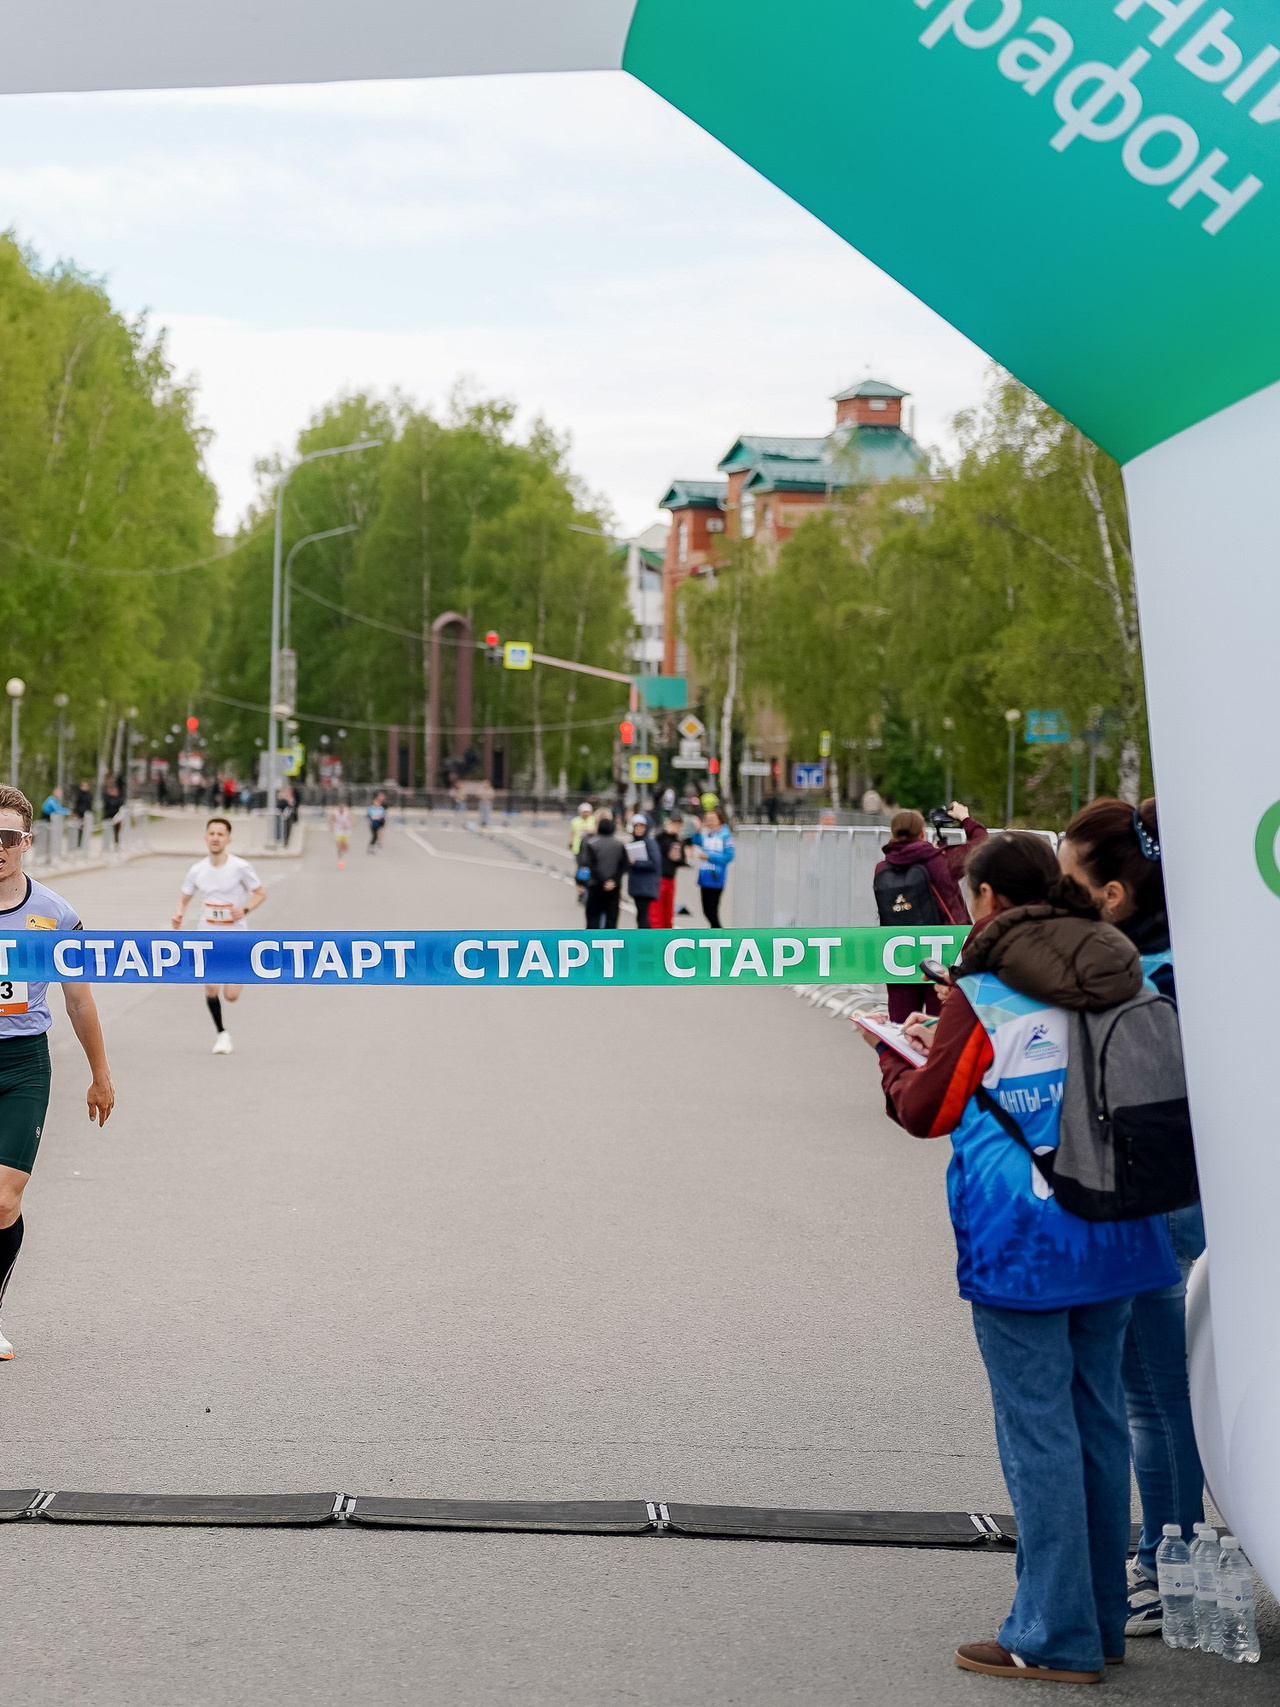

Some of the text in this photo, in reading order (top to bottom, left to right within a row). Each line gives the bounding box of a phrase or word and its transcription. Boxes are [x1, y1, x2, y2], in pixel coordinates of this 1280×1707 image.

[913, 0, 1264, 236] рафон
[53, 939, 214, 977] СТАРТ
[250, 940, 415, 979] СТАРТ
[453, 939, 625, 979] СТАРТ
[664, 937, 842, 977] СТАРТ
[882, 935, 969, 977] СТ
